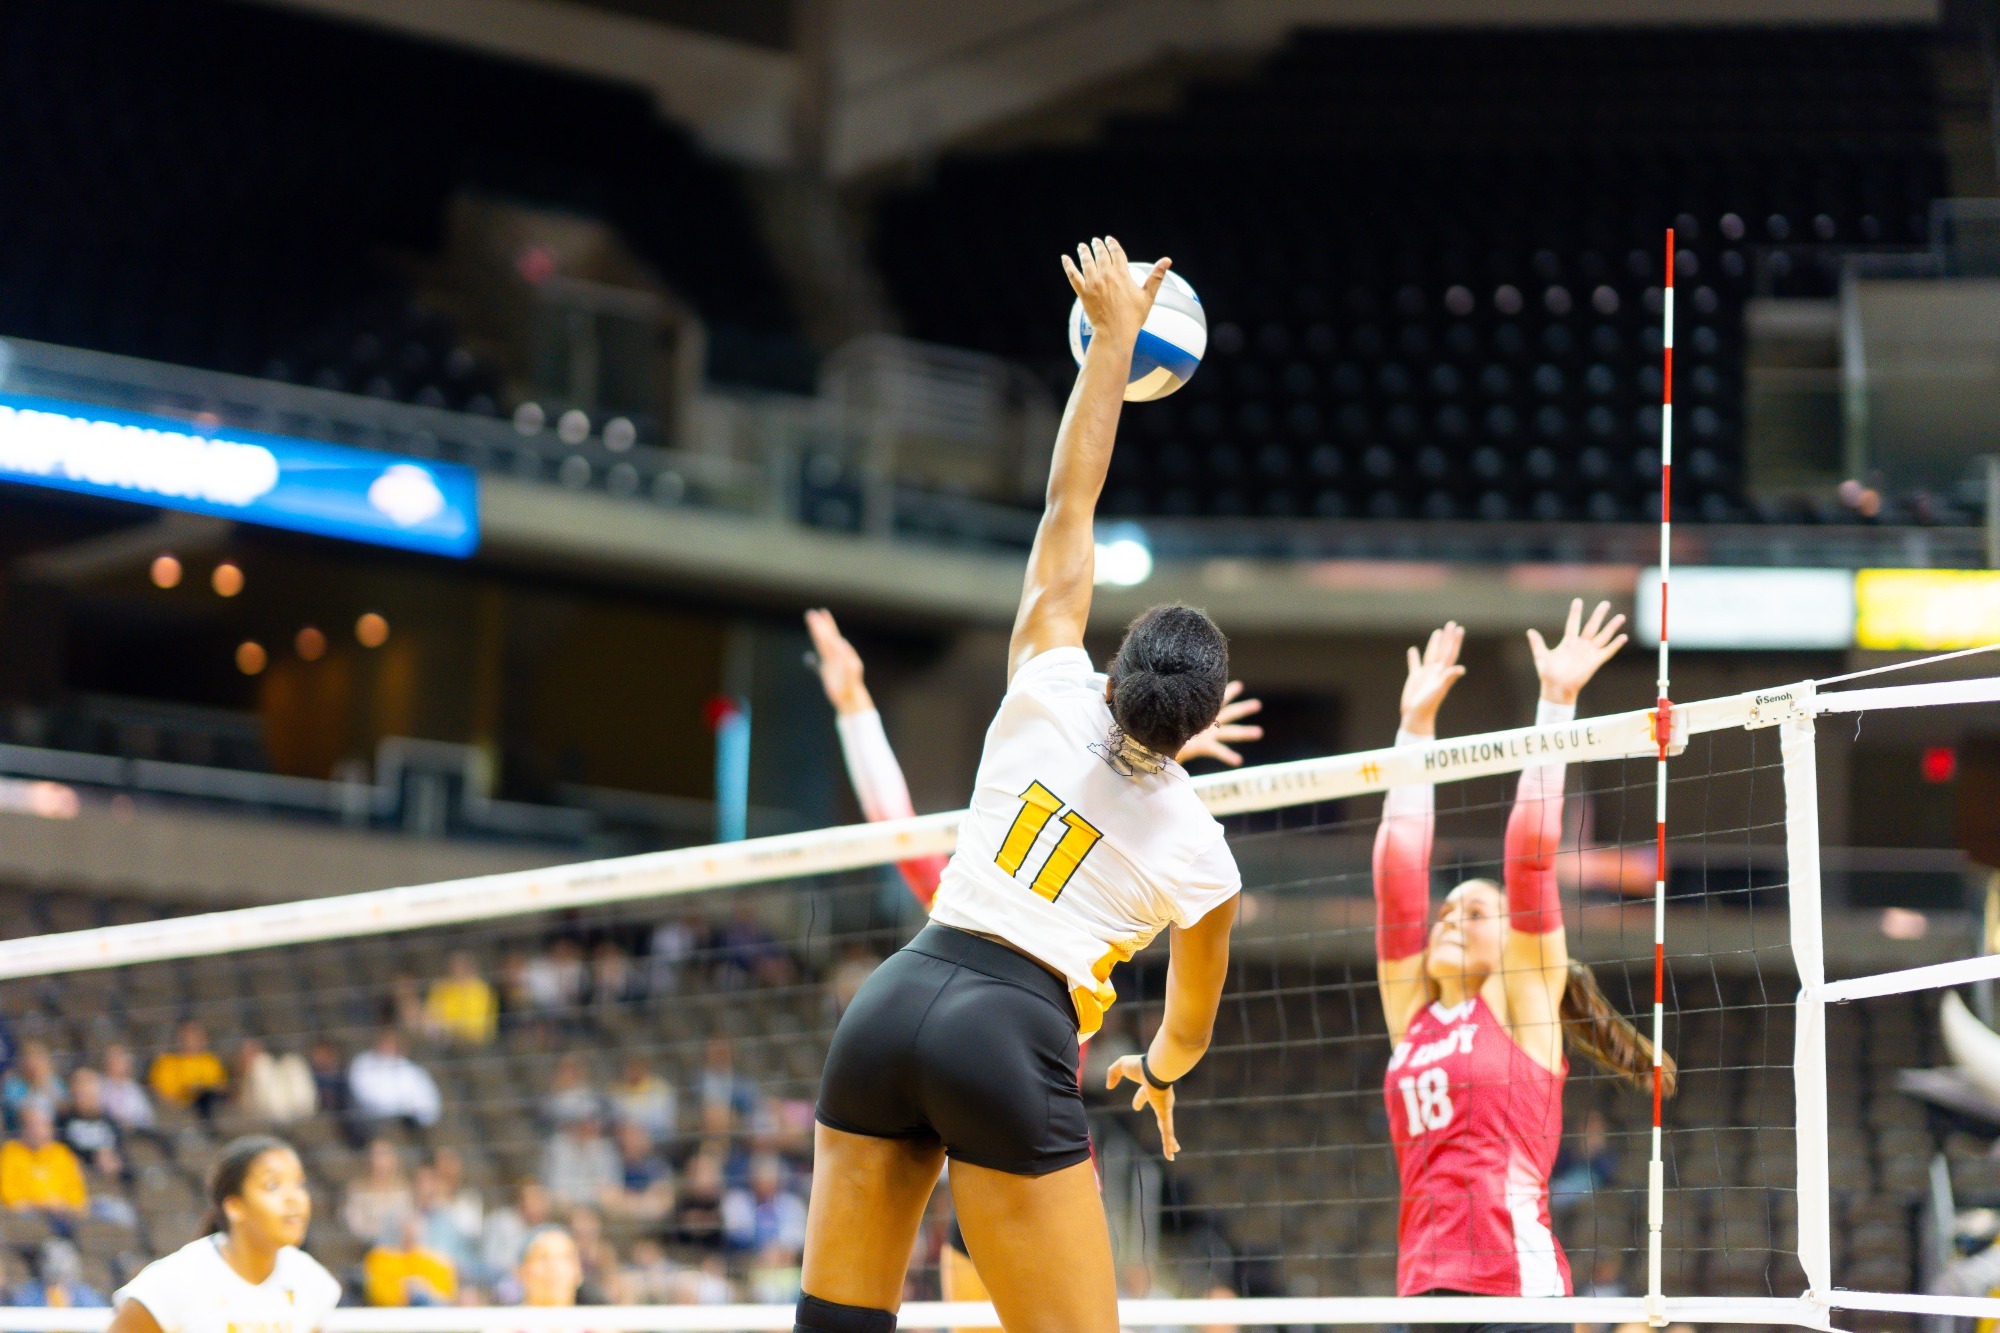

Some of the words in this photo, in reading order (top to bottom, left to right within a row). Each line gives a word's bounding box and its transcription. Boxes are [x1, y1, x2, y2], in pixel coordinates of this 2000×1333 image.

[1763, 692, 1793, 704] Senoh
[1424, 742, 1505, 770] HORIZON
[994, 779, 1104, 903] 11
[1399, 1067, 1453, 1137] 18
